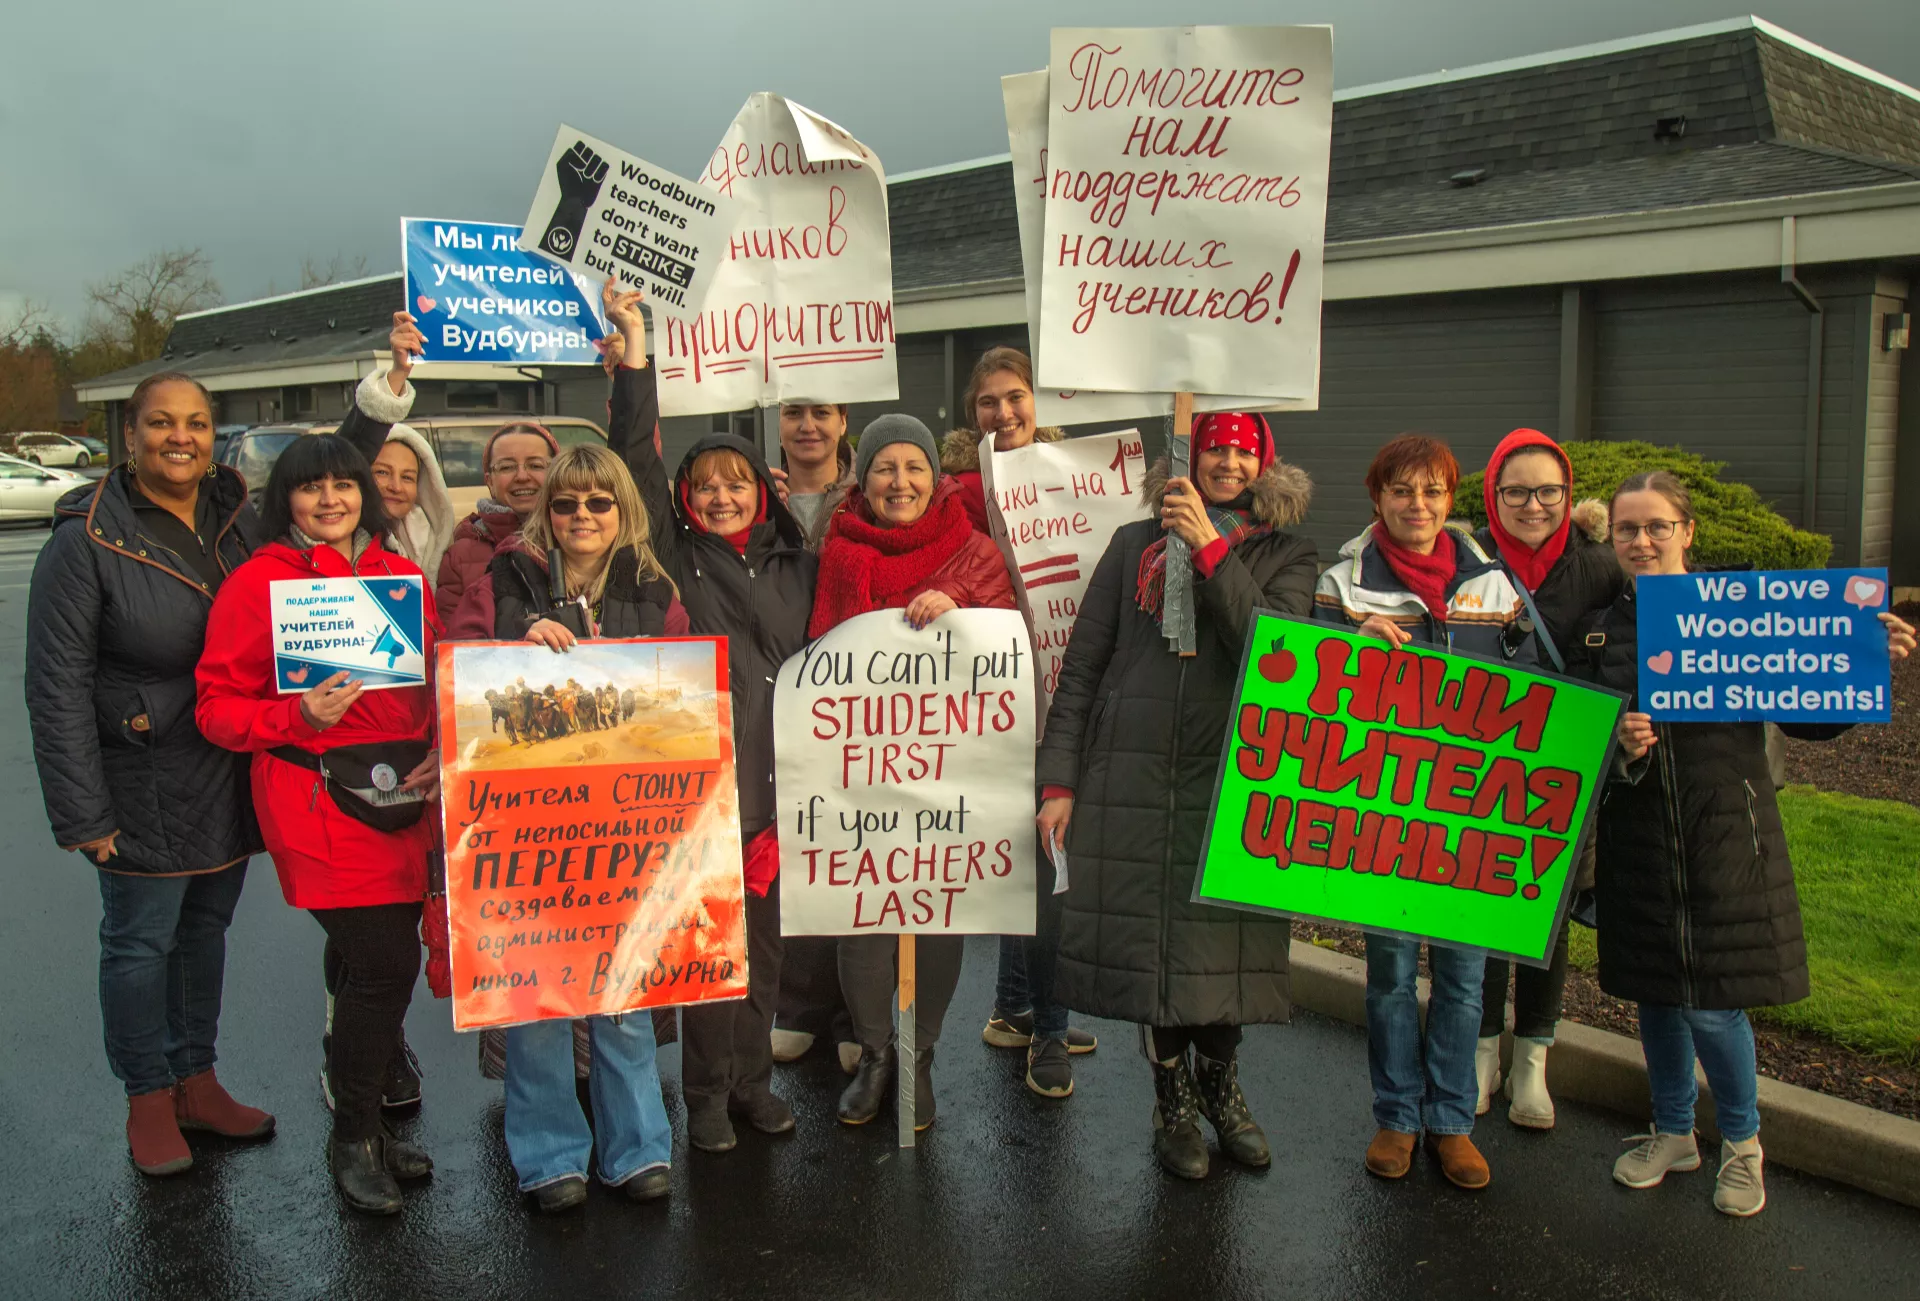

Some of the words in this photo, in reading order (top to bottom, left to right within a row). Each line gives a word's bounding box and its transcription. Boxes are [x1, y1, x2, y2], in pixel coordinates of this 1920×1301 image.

[1063, 43, 1304, 112] Помогите
[1122, 115, 1232, 158] нам
[610, 184, 687, 230] teachers
[620, 160, 716, 216] Woodburn
[1052, 168, 1301, 228] поддержать
[434, 225, 482, 249] Мы
[601, 208, 649, 239] don't
[654, 232, 699, 261] want
[1059, 234, 1233, 268] наших
[433, 263, 564, 286] учителей
[574, 275, 586, 288] и
[593, 229, 612, 247] to
[616, 239, 687, 285] STRIKE,
[585, 250, 615, 275] but
[620, 269, 645, 289] we
[651, 282, 686, 308] will.
[1071, 249, 1301, 334] учеников!
[446, 296, 580, 319] учеников
[442, 325, 587, 353] Вудбурна!
[1072, 473, 1106, 499] на
[286, 595, 354, 606] ПОДДЕРЖИВАЕМ
[312, 584, 326, 592] МЫ
[1695, 577, 1747, 602] We
[1758, 576, 1830, 600] love
[279, 617, 355, 633] УЧИТЕЛЕЙ
[309, 609, 339, 617] НАШИХ
[1676, 612, 1852, 638] Woodburn
[284, 637, 365, 651] ВУДБУРНА!
[796, 633, 853, 688] You
[866, 629, 959, 685] can't
[972, 637, 1024, 696] put
[1681, 648, 1850, 674] Educators
[811, 689, 1017, 740] STUDENTS
[1307, 637, 1557, 753] НАШИ
[1650, 685, 1713, 710] and
[1725, 684, 1884, 711] Students!
[842, 742, 957, 790] FIRST
[1236, 703, 1582, 834] УЧИТЕЛЯ
[459, 780, 590, 827] Учителя
[612, 770, 717, 805] СТОНУТ
[467, 830, 499, 849] от
[514, 808, 686, 845] непосильной
[797, 795, 825, 842] if
[839, 809, 899, 851] you
[915, 795, 972, 843] put
[801, 838, 1013, 888] TEACHERS
[1241, 791, 1569, 901] ЦЕННЫЕ!
[852, 887, 967, 928] LAST
[472, 969, 538, 997] школ
